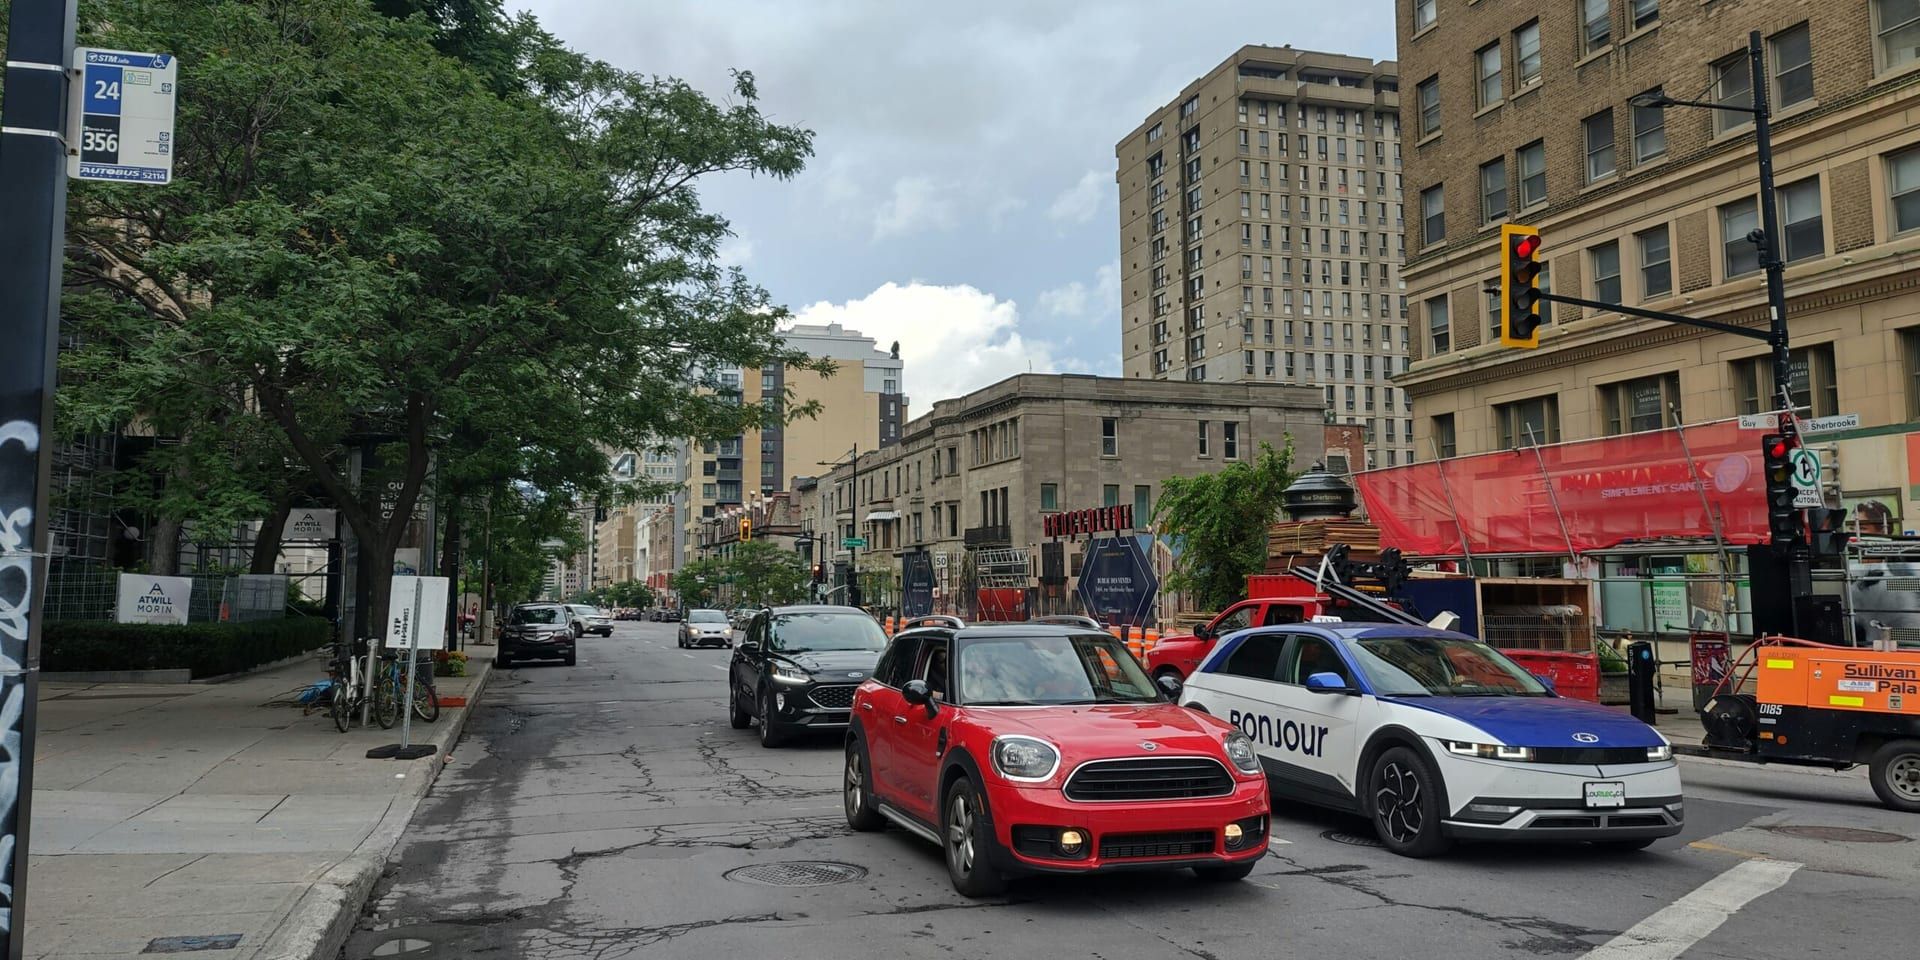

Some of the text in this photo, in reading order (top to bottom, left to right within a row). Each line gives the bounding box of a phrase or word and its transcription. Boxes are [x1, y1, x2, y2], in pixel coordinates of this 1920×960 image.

[94, 80, 120, 100] 24
[83, 132, 118, 152] 356
[80, 167, 140, 177] AUTOBUS
[142, 172, 165, 180] 52114
[1742, 420, 1756, 428] Guy
[1811, 418, 1856, 431] Sherbrooke
[1601, 483, 1669, 499] SIMPLEMENT
[1795, 496, 1819, 504] AUTOBU
[936, 557, 947, 566] 50
[139, 596, 172, 605] ATWILL
[137, 605, 172, 614] MORIN
[393, 618, 401, 635] STP
[1844, 663, 1916, 679] Sullivan
